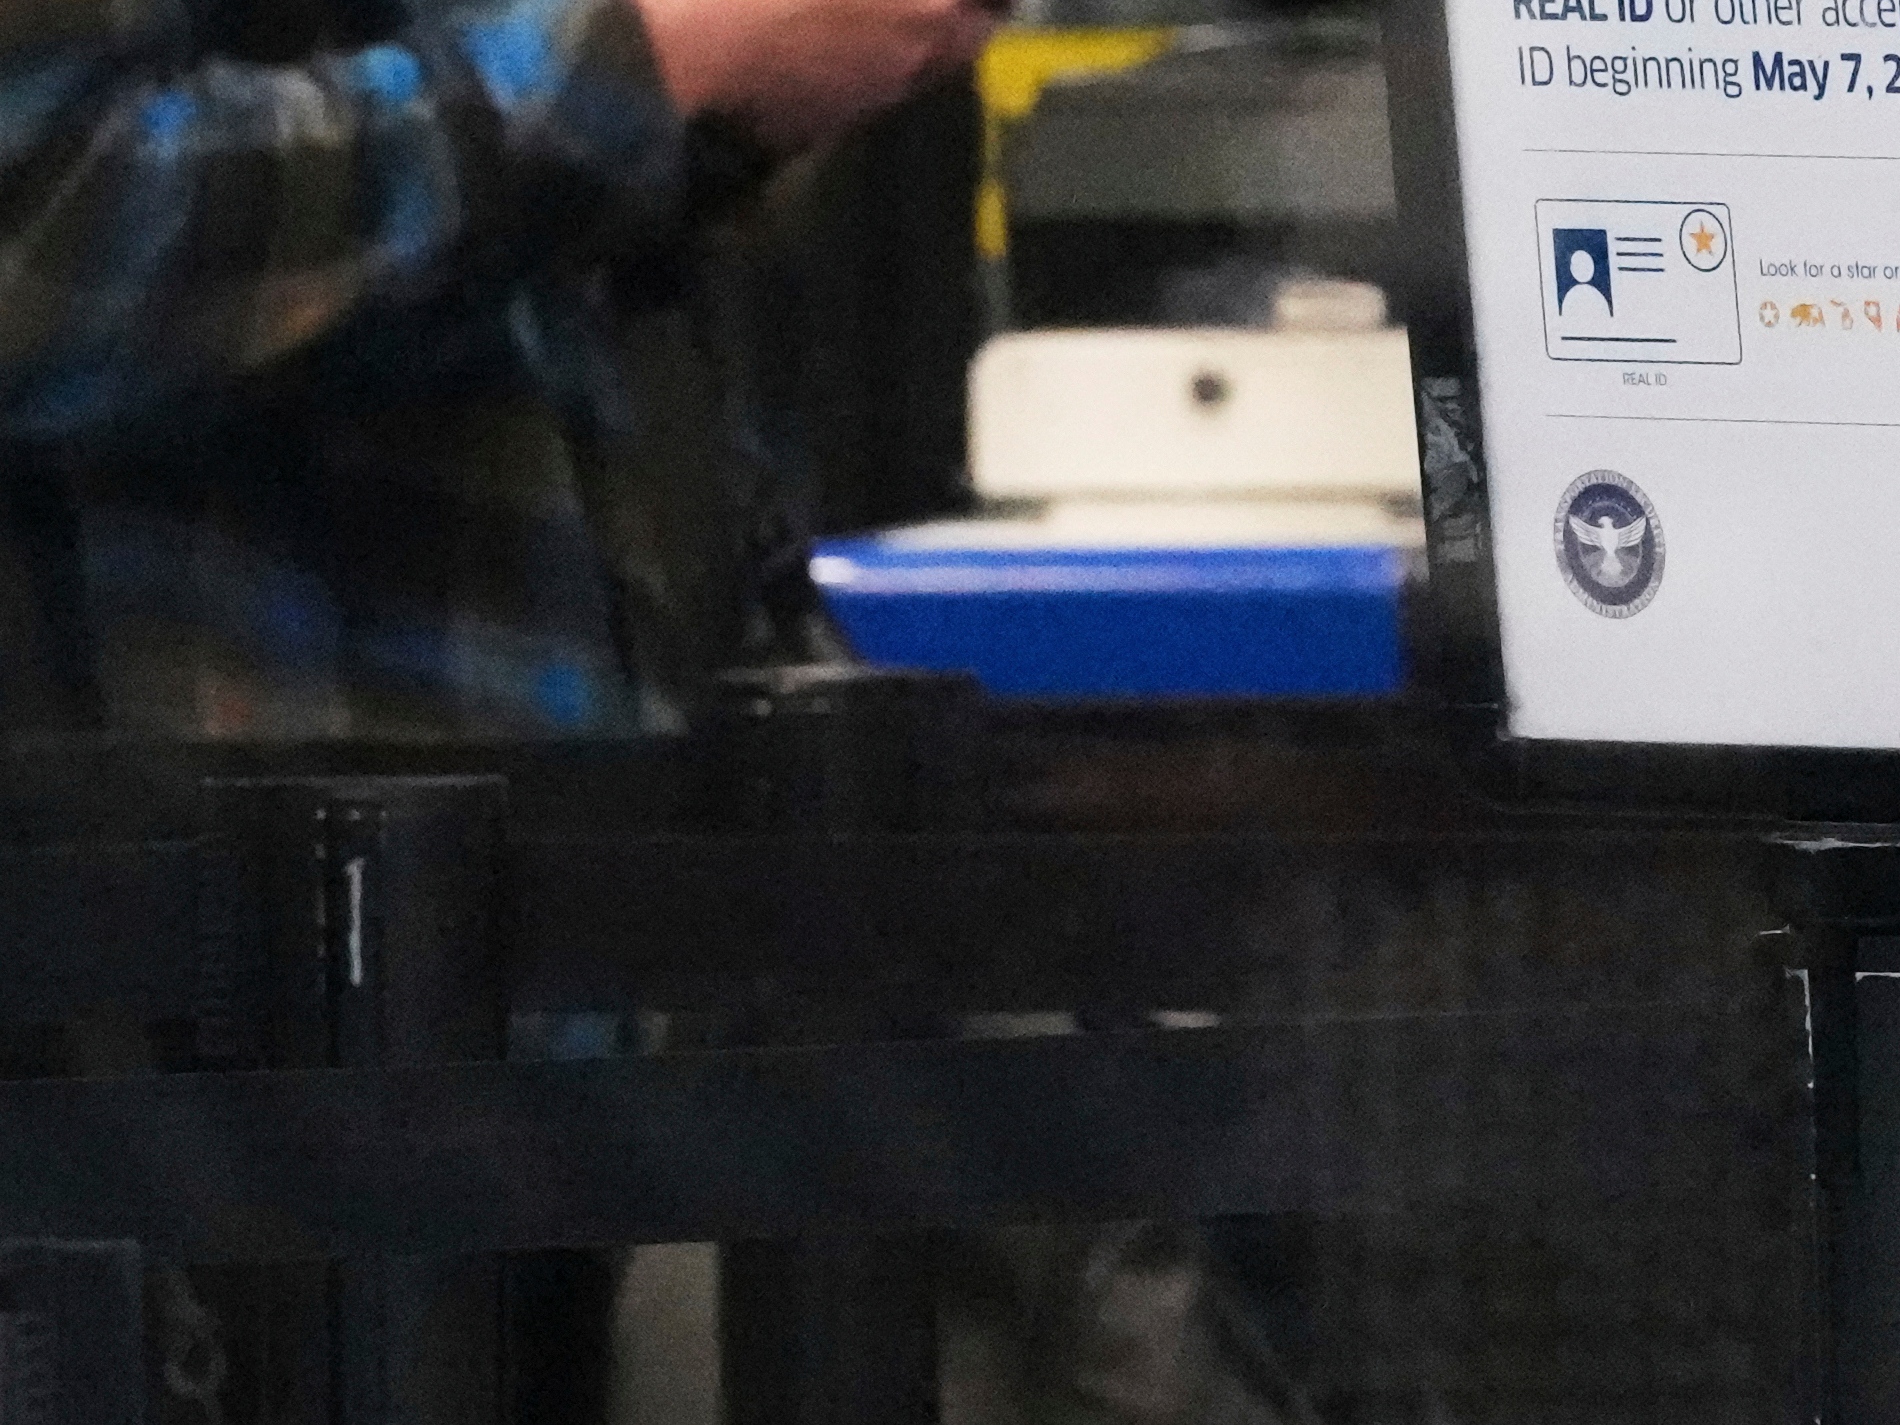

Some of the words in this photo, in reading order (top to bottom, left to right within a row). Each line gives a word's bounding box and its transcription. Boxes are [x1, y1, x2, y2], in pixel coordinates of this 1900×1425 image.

[1518, 46, 1554, 86] ID
[1566, 45, 1742, 98] beginning
[1752, 51, 1829, 101] May
[1840, 53, 1873, 100] 7,
[1759, 259, 1798, 278] Look
[1803, 260, 1824, 278] for
[1830, 265, 1842, 278] a
[1847, 261, 1877, 279] star
[1883, 266, 1899, 280] or
[1622, 372, 1652, 386] REAL
[1655, 372, 1667, 386] ID
